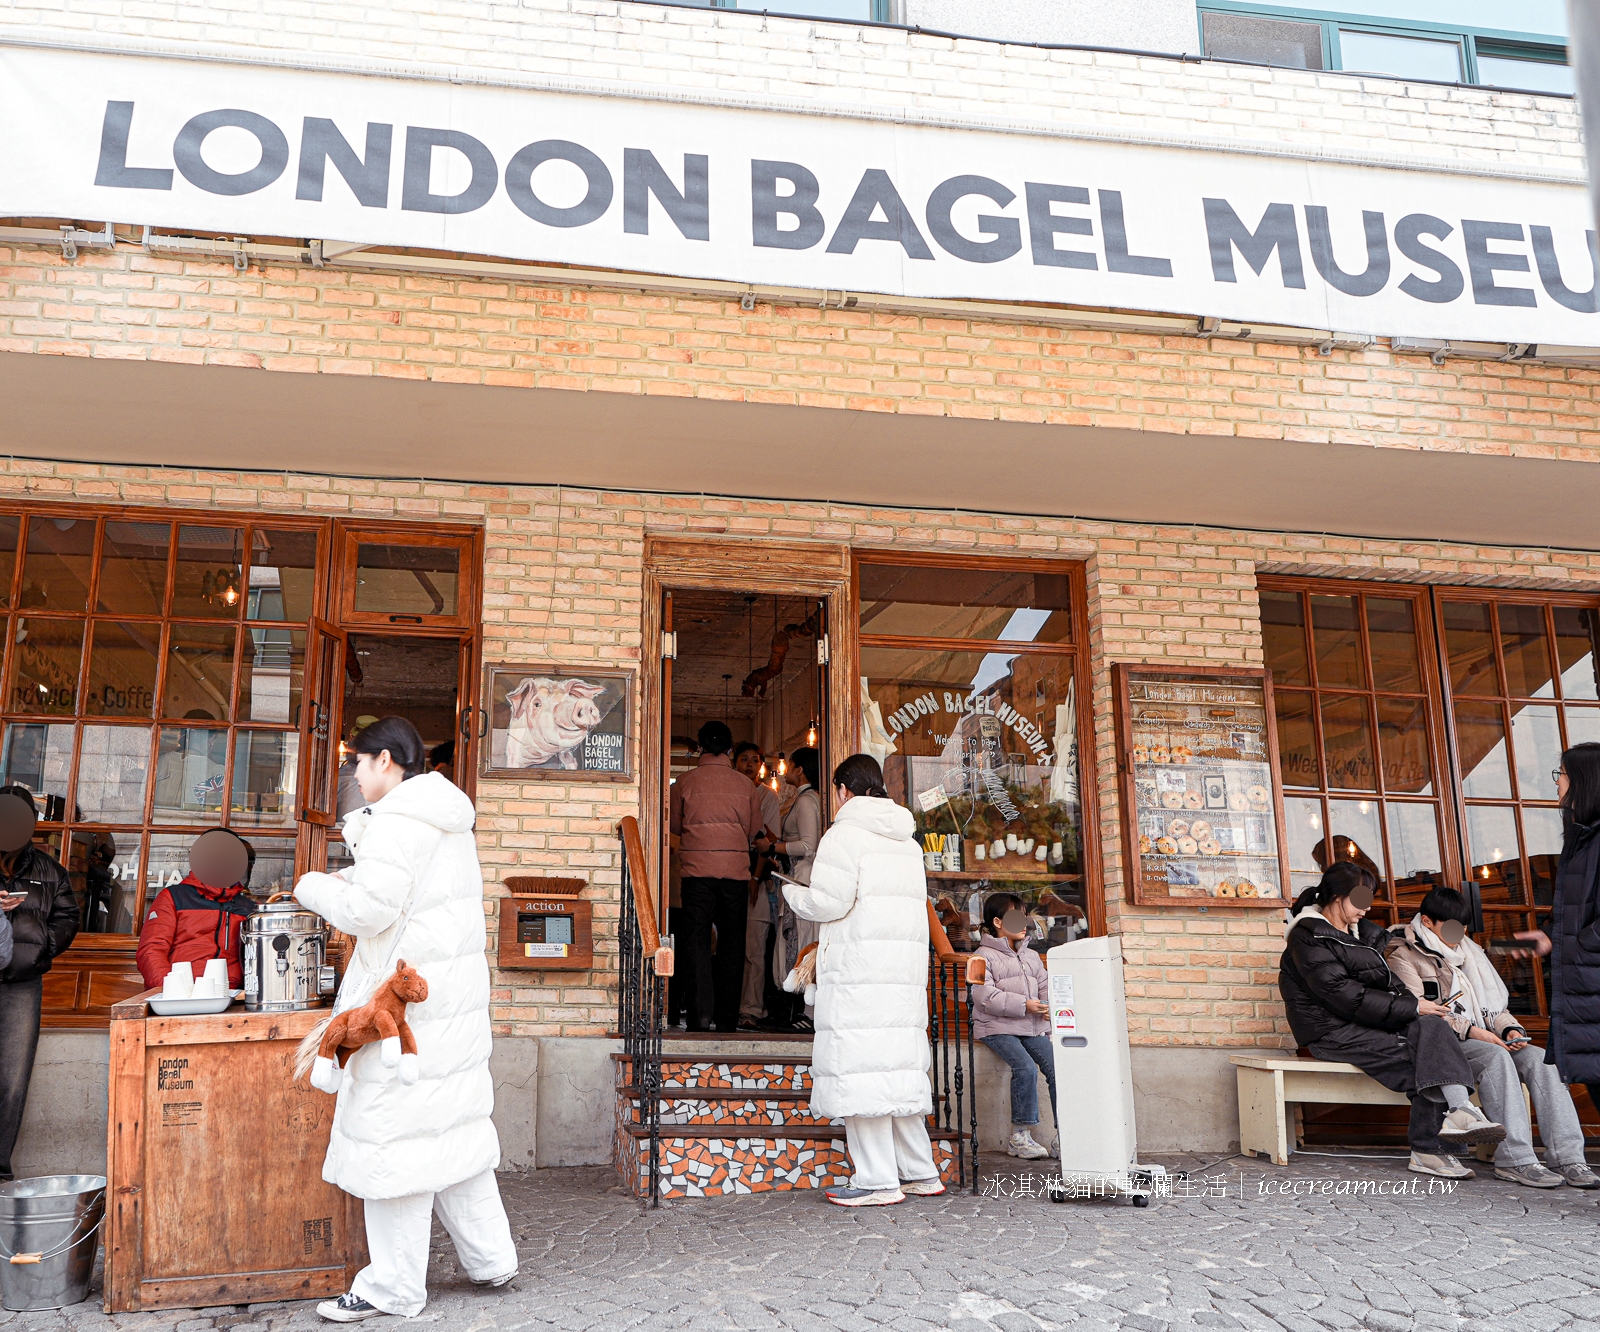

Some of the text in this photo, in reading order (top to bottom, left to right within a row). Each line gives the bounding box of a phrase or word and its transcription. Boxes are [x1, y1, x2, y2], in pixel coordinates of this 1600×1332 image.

[94, 100, 710, 241] LONDON
[751, 159, 1173, 279] BAGEL
[1144, 685, 1237, 703] London Bagel Museum
[876, 692, 1049, 755] LONDON BAGEL MUSEUM
[585, 734, 623, 748] LONDON
[584, 747, 615, 759] BAGEL
[584, 758, 622, 771] MUSEUM
[526, 900, 565, 912] action
[158, 1057, 189, 1070] London
